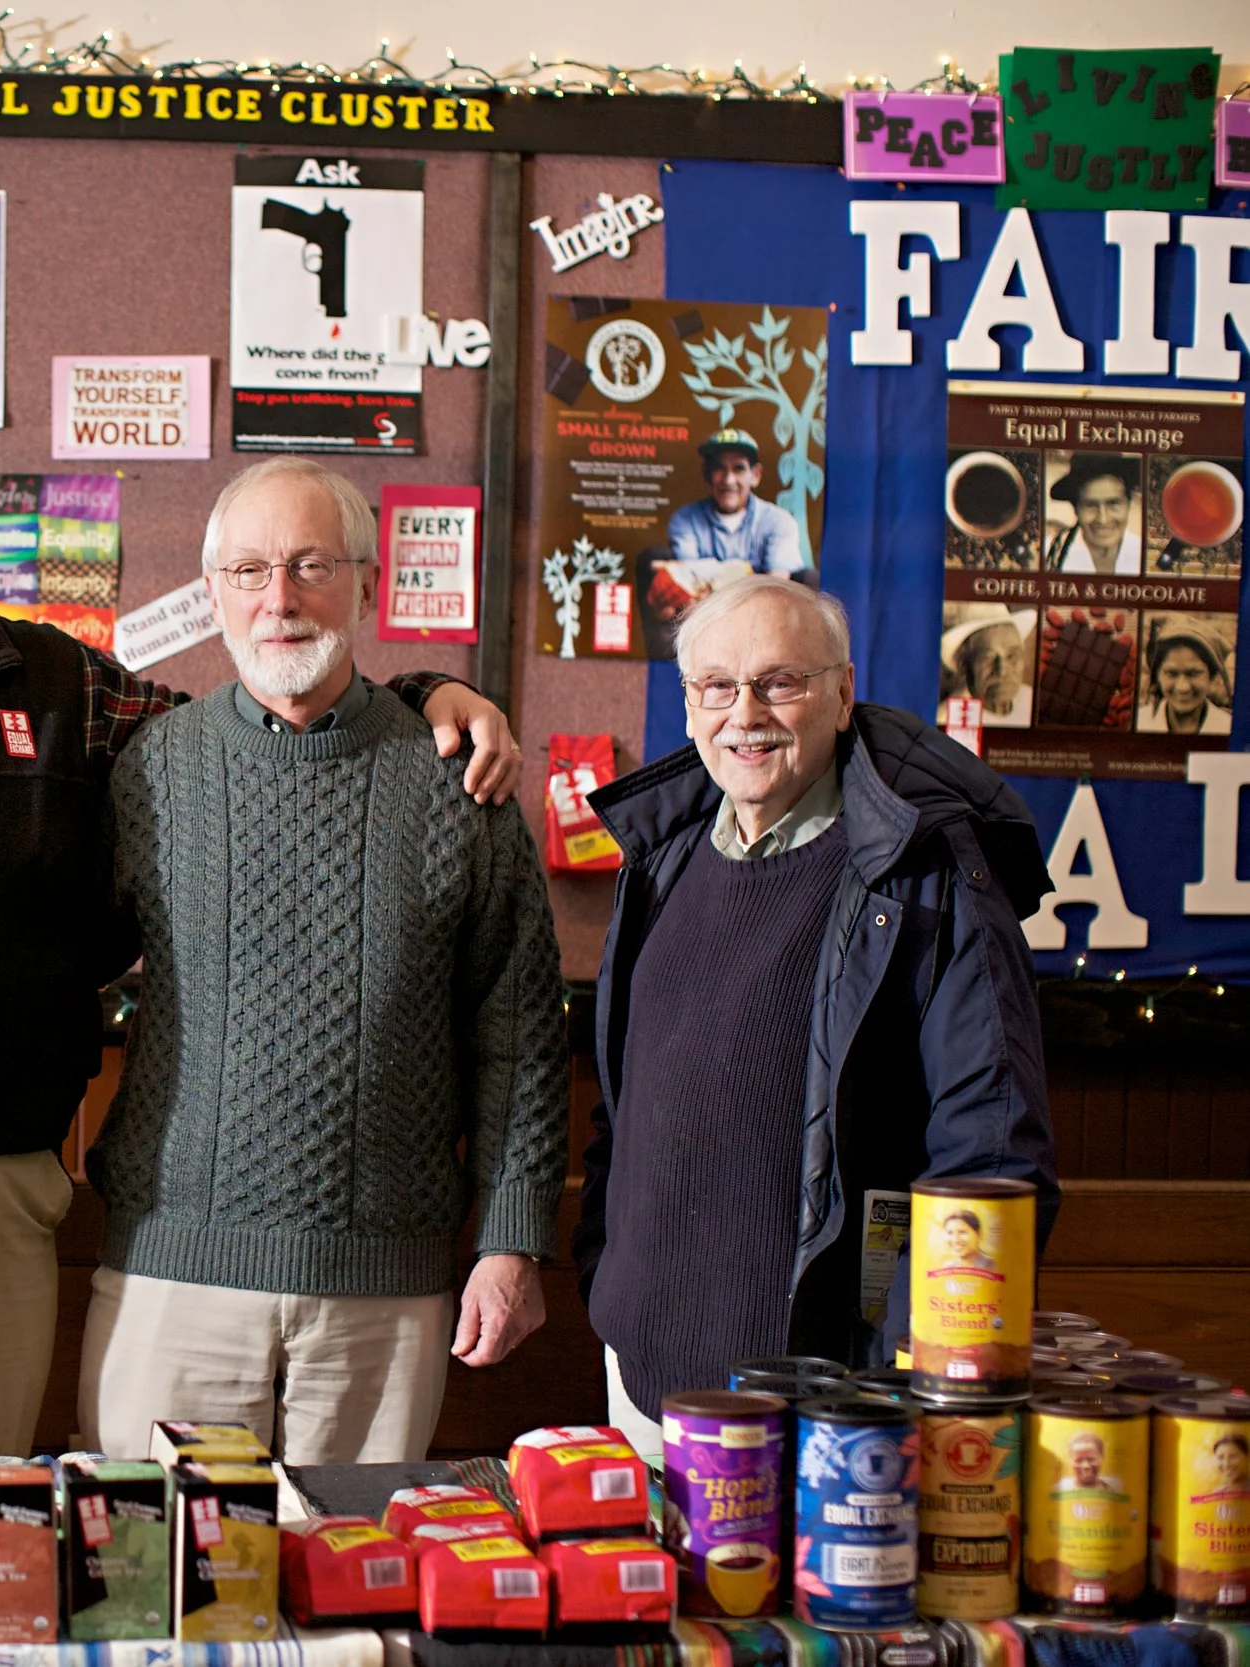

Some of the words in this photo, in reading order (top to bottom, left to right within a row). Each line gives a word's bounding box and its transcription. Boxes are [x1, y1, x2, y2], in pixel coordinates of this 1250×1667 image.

[1012, 55, 1216, 120] LIVING
[53, 84, 262, 122] JUSTICE
[280, 90, 496, 133] CLUSTER
[856, 107, 998, 168] PEACE
[295, 158, 361, 187] Ask
[1023, 133, 1207, 191] JUSTLY
[529, 192, 665, 274] Imagine
[247, 346, 306, 361] Where
[312, 347, 338, 361] did
[343, 348, 369, 362] the
[73, 368, 182, 384] TRANSFORM
[276, 369, 322, 380] come
[328, 368, 379, 382] from?
[73, 387, 187, 407] YOURSELF,
[73, 407, 150, 418] TRANSFORM
[156, 408, 181, 419] THE
[1065, 406, 1093, 419] FROM
[557, 421, 614, 438] SMALL
[618, 423, 689, 441] FARMER
[1005, 417, 1068, 447] Equal
[1077, 421, 1185, 451] Exchange
[588, 441, 657, 458] GROWN
[43, 483, 113, 512] Justice
[398, 516, 466, 536] EVERY
[43, 527, 114, 555] Equality
[397, 541, 460, 567] HUMAN
[40, 569, 112, 599] Integrity
[396, 569, 436, 589] HAS
[973, 578, 1042, 599] COFFEE,
[1048, 580, 1079, 599] TEA
[1084, 582, 1097, 599] &
[1102, 582, 1207, 604] CHOCOLATE
[393, 592, 465, 617] RIGHTS
[121, 608, 168, 637] Stand
[170, 599, 191, 616] up
[122, 631, 181, 662] Human
[940, 1314, 989, 1329] Blend
[823, 1503, 861, 1526] EQUAL
